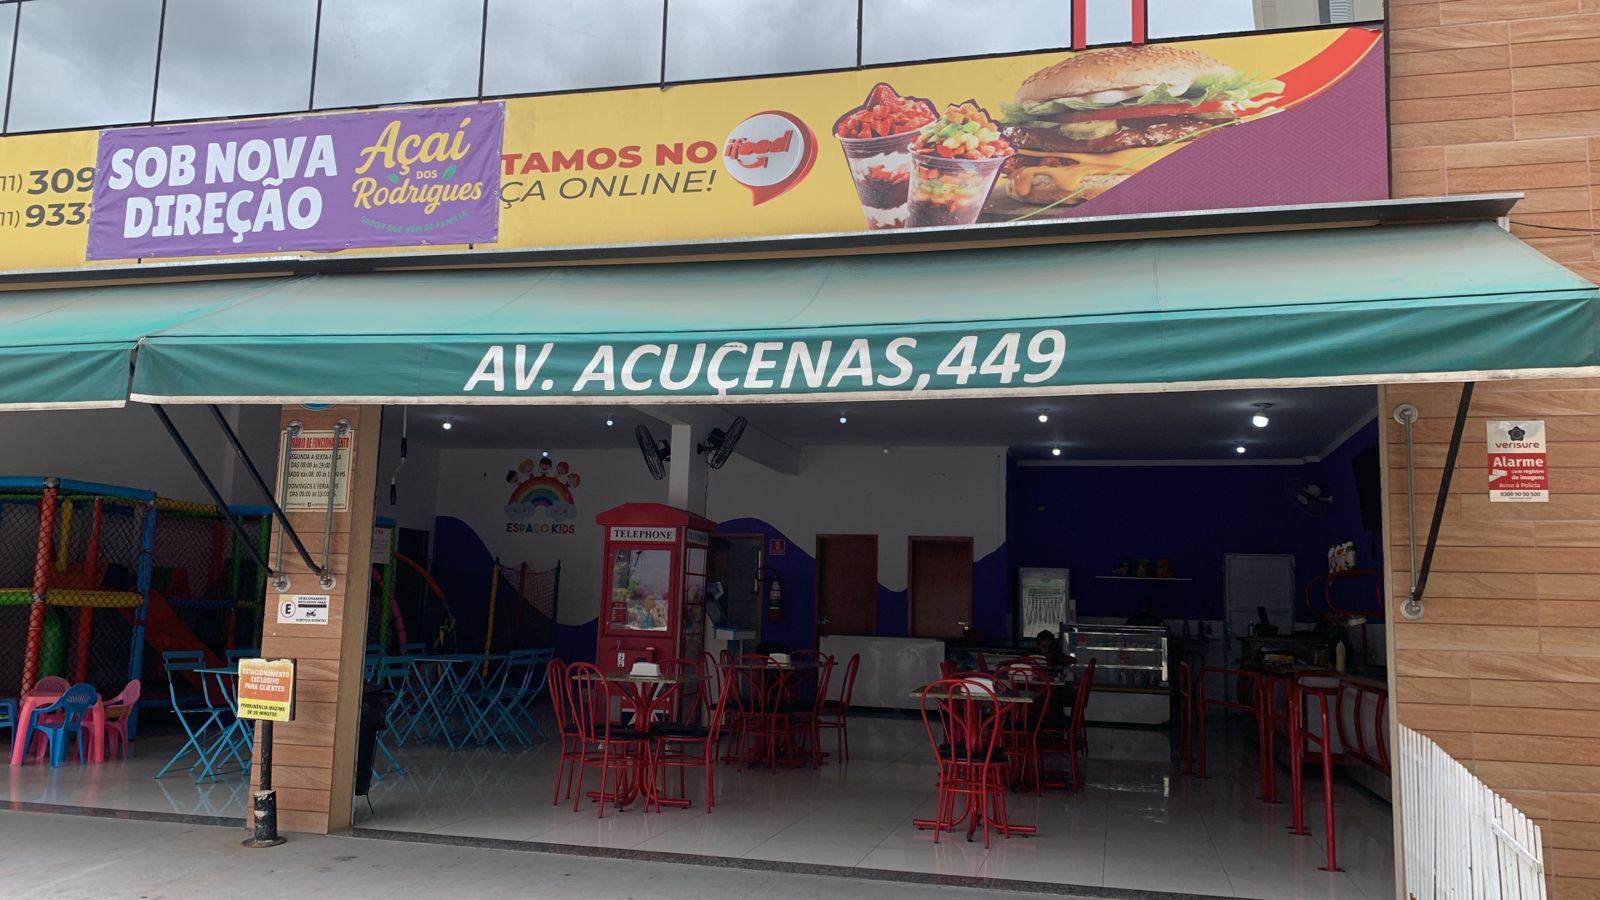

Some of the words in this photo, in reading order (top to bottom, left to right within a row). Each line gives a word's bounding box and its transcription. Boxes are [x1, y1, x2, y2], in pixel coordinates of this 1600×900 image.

[355, 117, 471, 175] Açaí
[655, 141, 717, 166] NO
[108, 145, 196, 190] SOB
[205, 135, 338, 184] NOVA
[416, 170, 437, 180] DOS
[559, 170, 717, 199] ONLINE!
[352, 177, 483, 215] Rodrigues
[25, 202, 93, 227] 933
[124, 177, 322, 243] DIREÇÃO
[463, 343, 554, 391] AV.
[1495, 441, 1540, 449] verisure
[1493, 456, 1544, 467] Alarme
[552, 523, 575, 534] KIDS
[613, 529, 673, 539] TELEPHONE
[285, 603, 292, 614] E
[243, 668, 289, 678] ESTACIONAMENTO
[250, 676, 280, 685] EXCLUSIVO
[244, 682, 258, 690] PARA
[259, 684, 285, 692] CLIENTES
